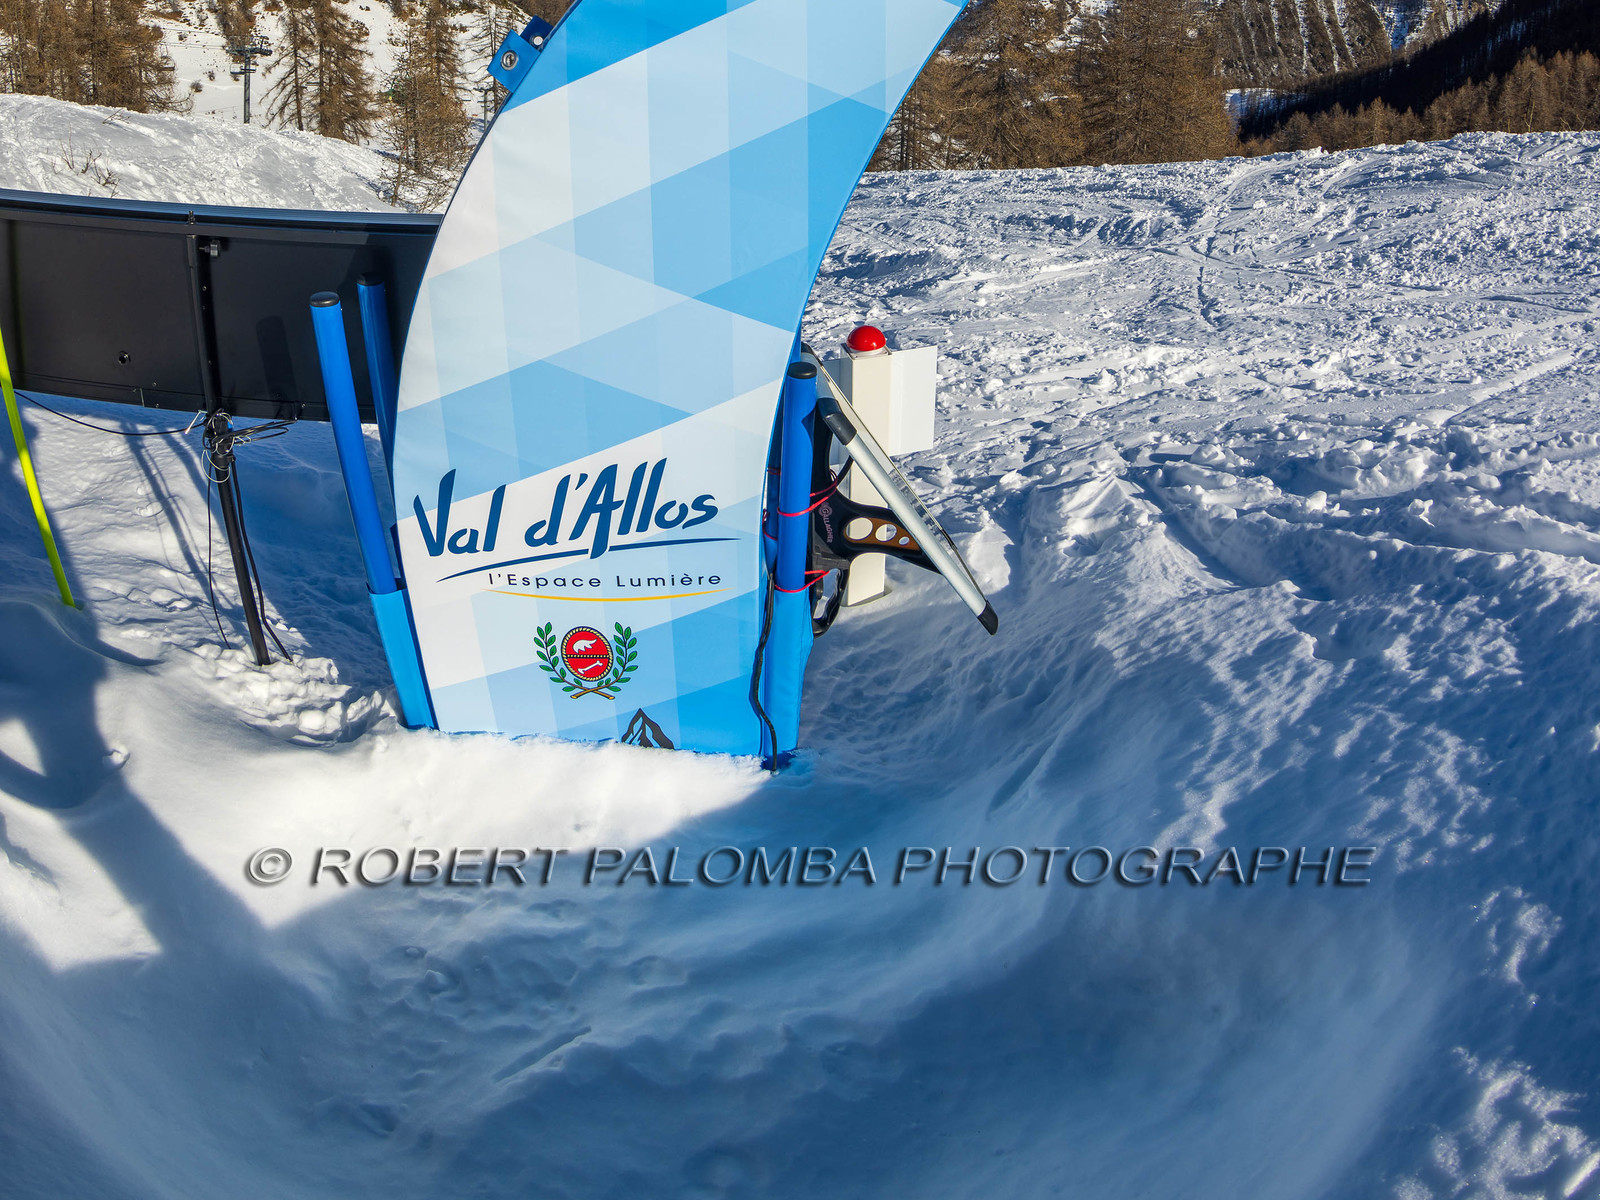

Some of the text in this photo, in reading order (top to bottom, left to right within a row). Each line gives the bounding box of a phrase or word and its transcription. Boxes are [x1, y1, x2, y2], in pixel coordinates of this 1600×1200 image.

[413, 457, 719, 560] Val d'Allos
[488, 573, 722, 589] l'Espace Lumière
